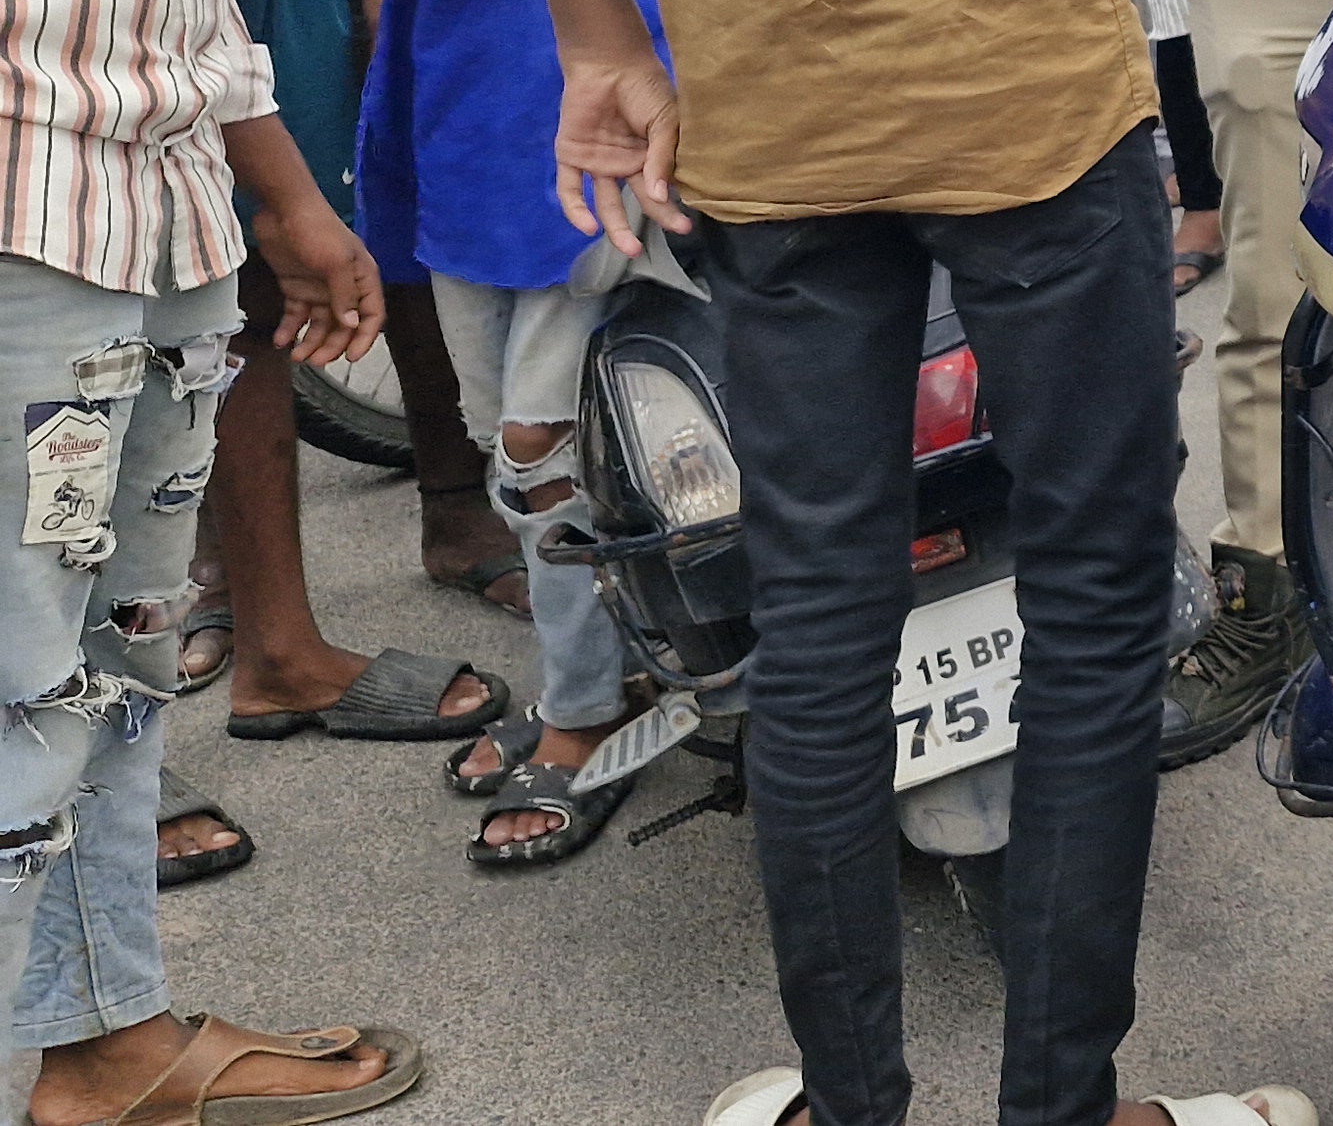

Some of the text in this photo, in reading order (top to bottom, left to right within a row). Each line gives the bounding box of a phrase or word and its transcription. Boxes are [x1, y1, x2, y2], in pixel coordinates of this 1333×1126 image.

[46, 436, 106, 455] Roadster
[916, 646, 958, 685] 15
[966, 627, 1014, 669] BP
